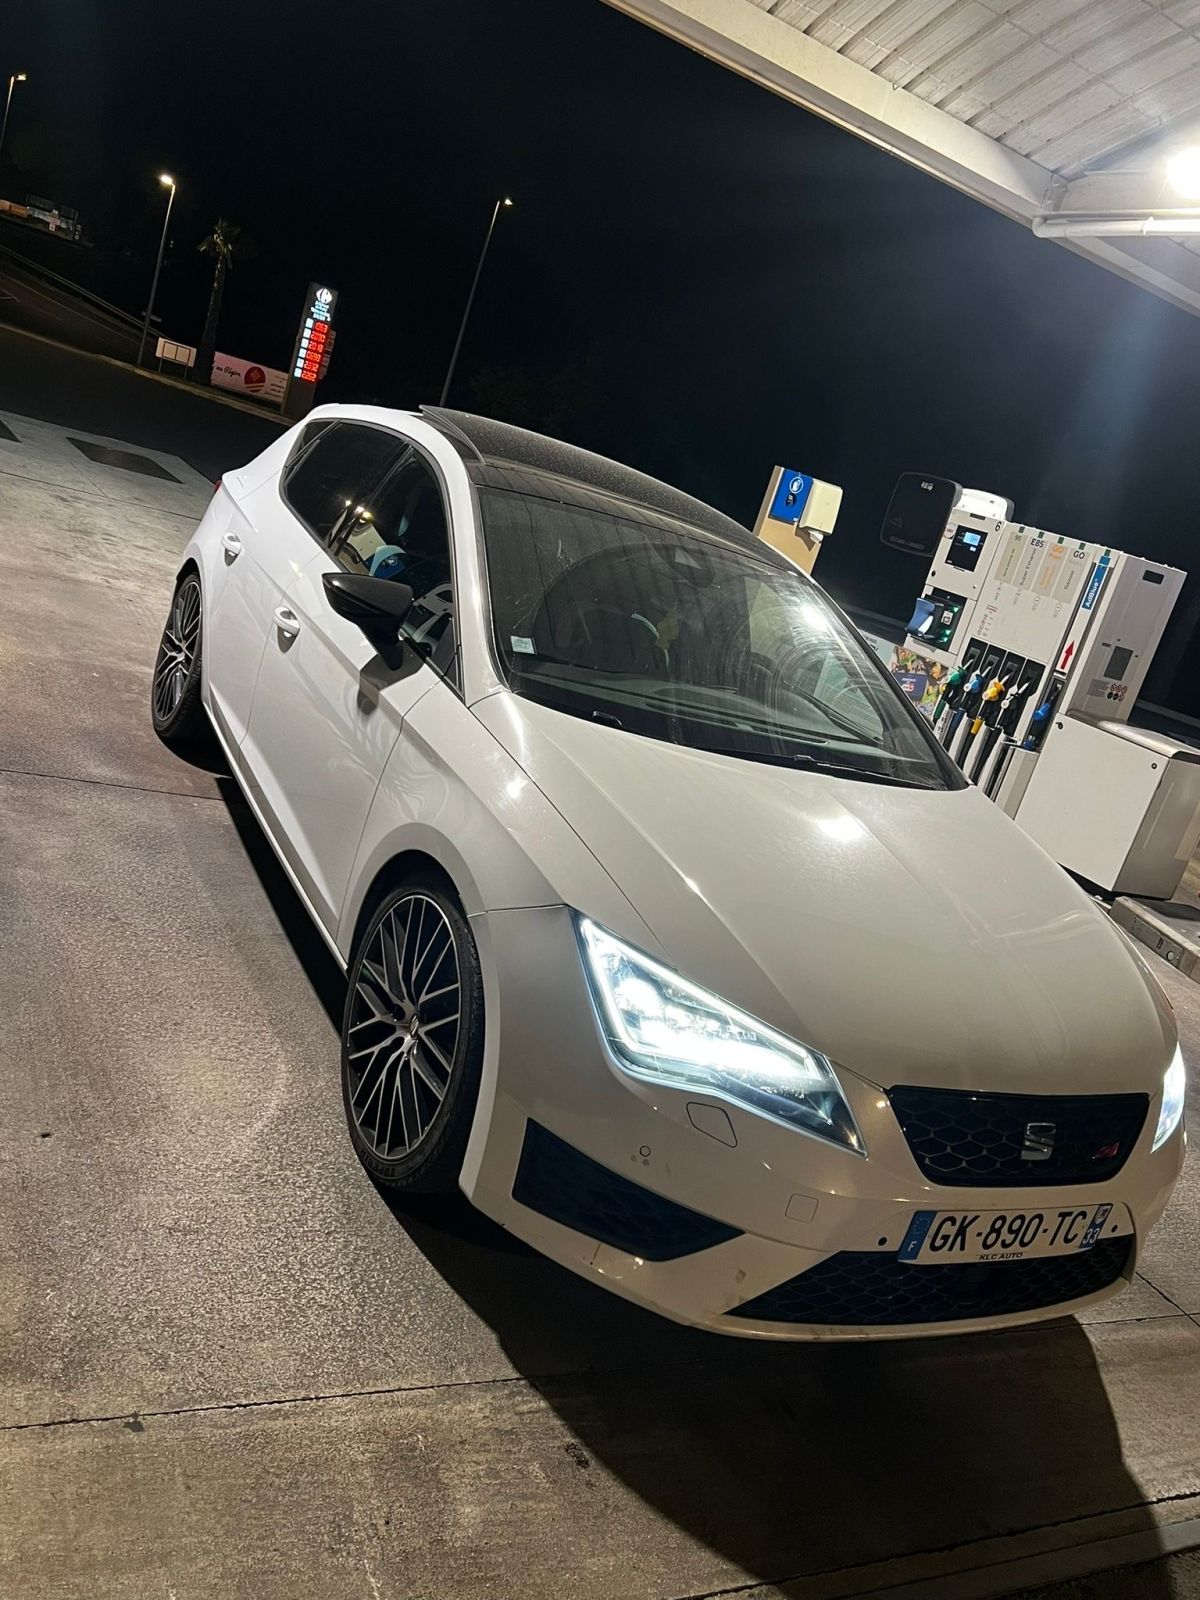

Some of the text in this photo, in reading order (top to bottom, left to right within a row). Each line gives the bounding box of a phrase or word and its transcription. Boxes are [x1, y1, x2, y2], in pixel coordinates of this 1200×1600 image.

[995, 521, 1002, 532] 6
[1030, 538, 1045, 548] E85
[1073, 550, 1086, 560] GO
[929, 1210, 1088, 1253] GK-890-TC
[1082, 1227, 1100, 1244] 33
[908, 1240, 918, 1252] F
[979, 1252, 1024, 1261] KLC AUTO
